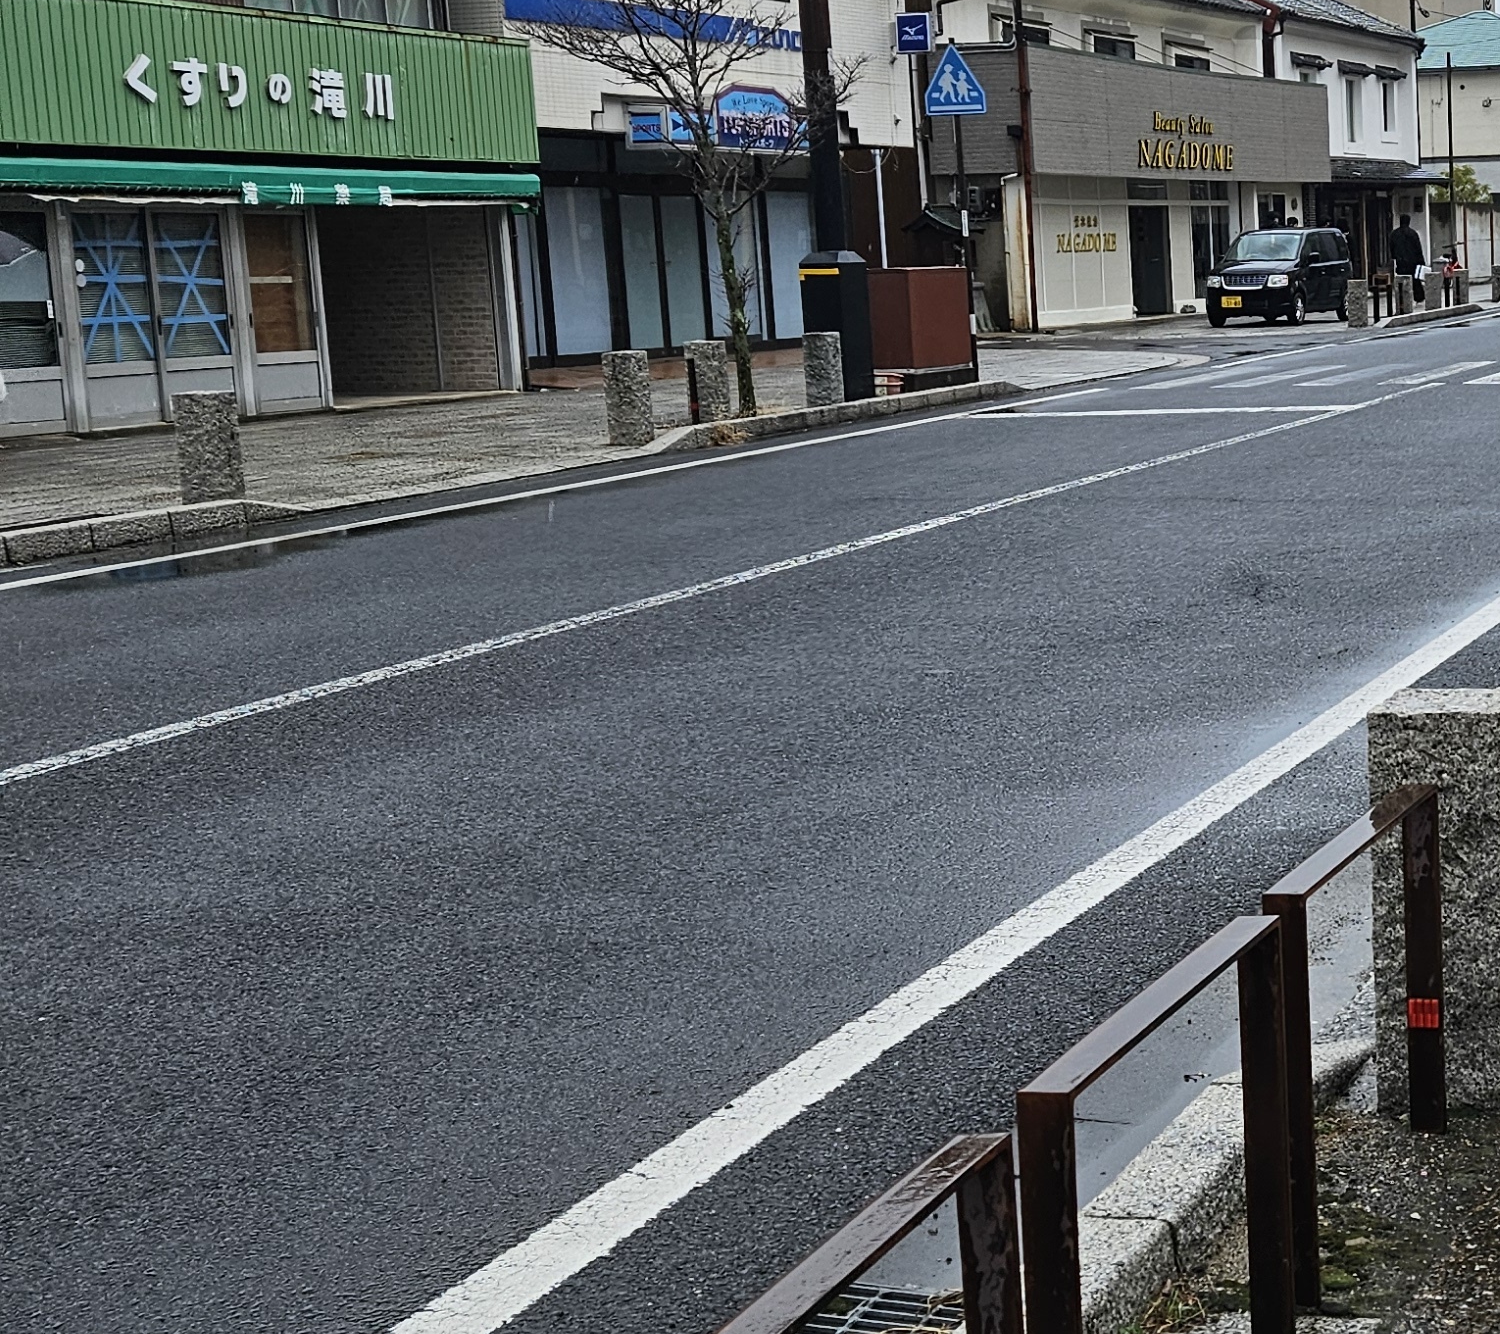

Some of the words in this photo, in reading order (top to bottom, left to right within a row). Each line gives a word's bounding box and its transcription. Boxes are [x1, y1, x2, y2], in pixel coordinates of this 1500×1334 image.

[123, 53, 395, 121] くすりの滝川
[1153, 111, 1185, 139] Beauty
[1188, 114, 1215, 135] Salon
[1138, 138, 1234, 171] NAGADOME
[1056, 233, 1117, 254] NAGADOME
